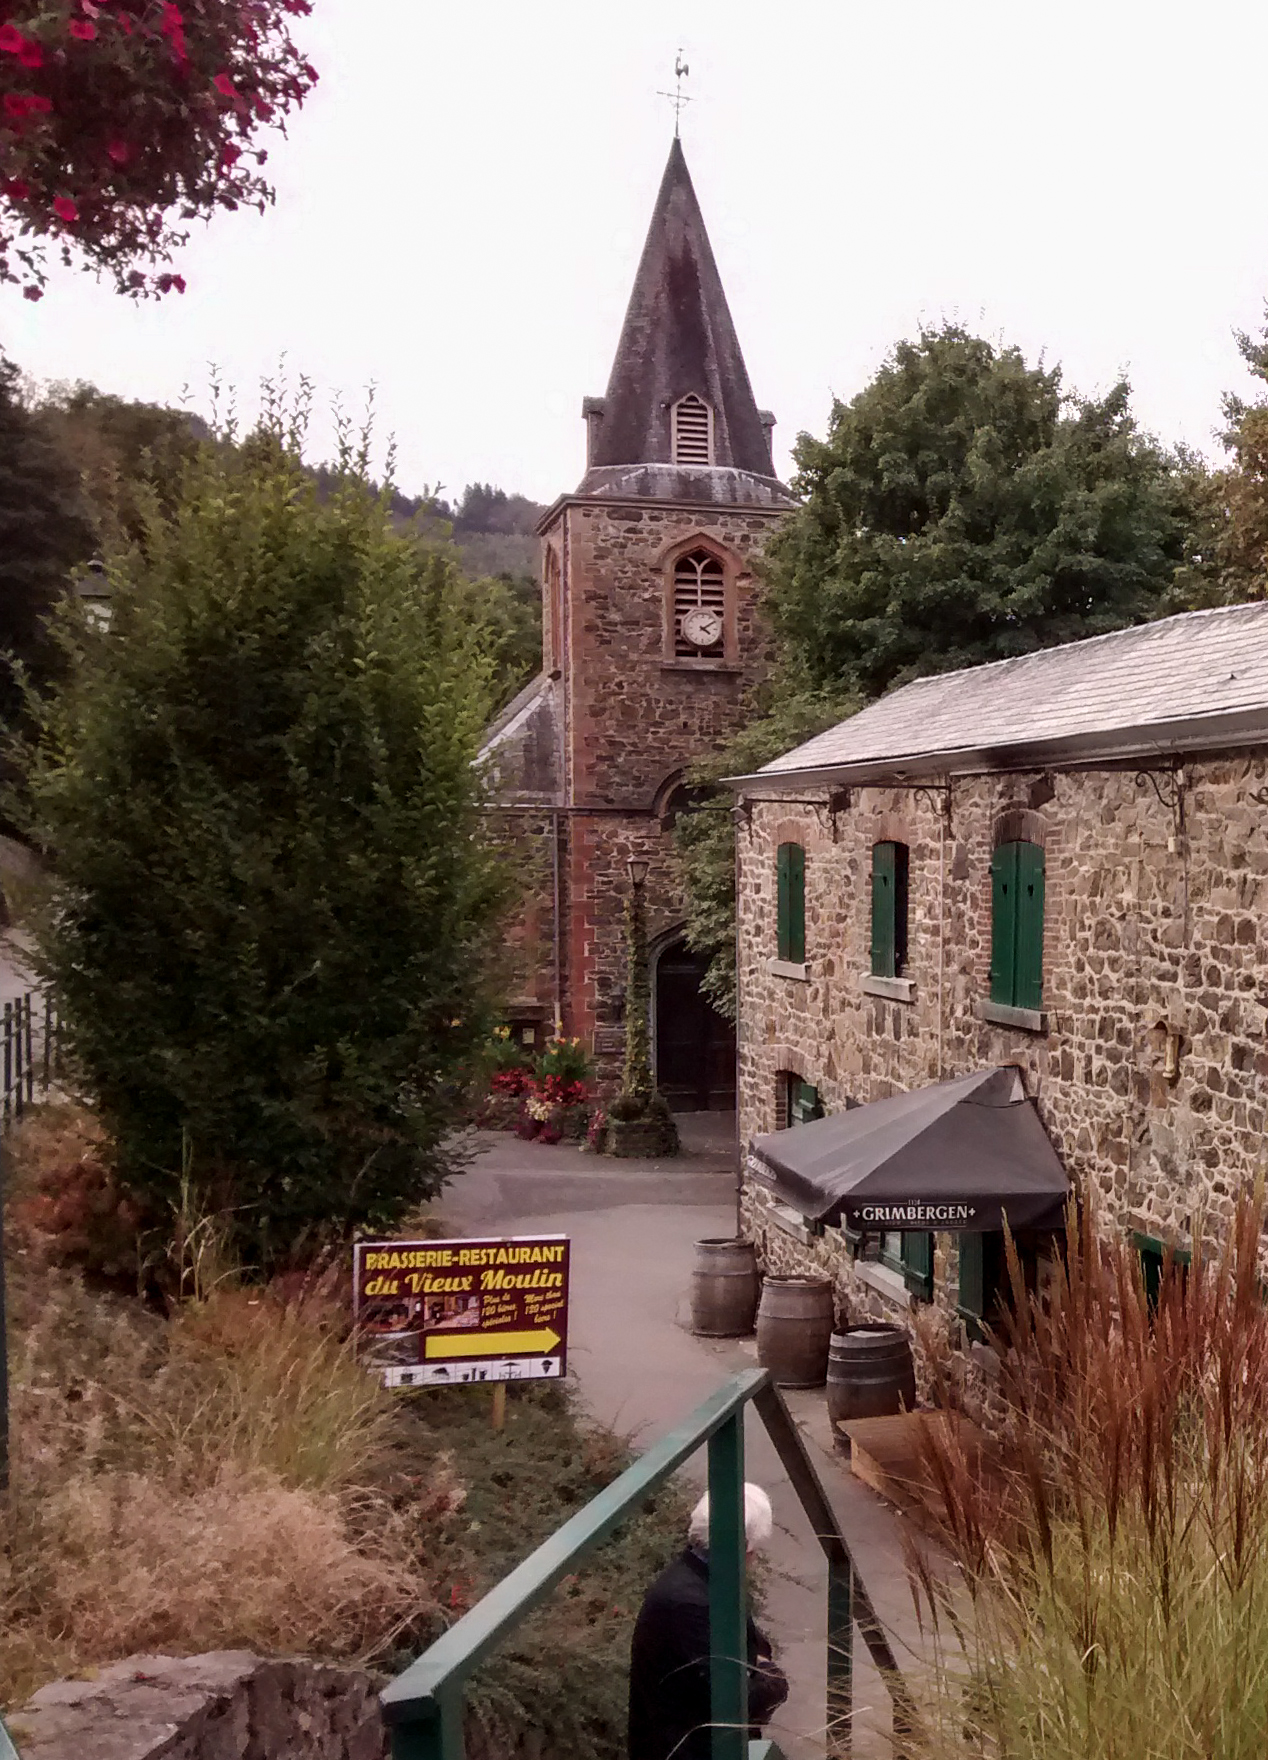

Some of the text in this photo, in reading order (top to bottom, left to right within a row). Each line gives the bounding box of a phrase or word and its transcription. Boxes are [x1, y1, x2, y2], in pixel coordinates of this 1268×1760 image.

[862, 1205, 968, 1221] GRIMBERGEN
[365, 1246, 565, 1270] BRASSERIE-RESTAURANT
[364, 1268, 563, 1296] du Vieux Moulin
